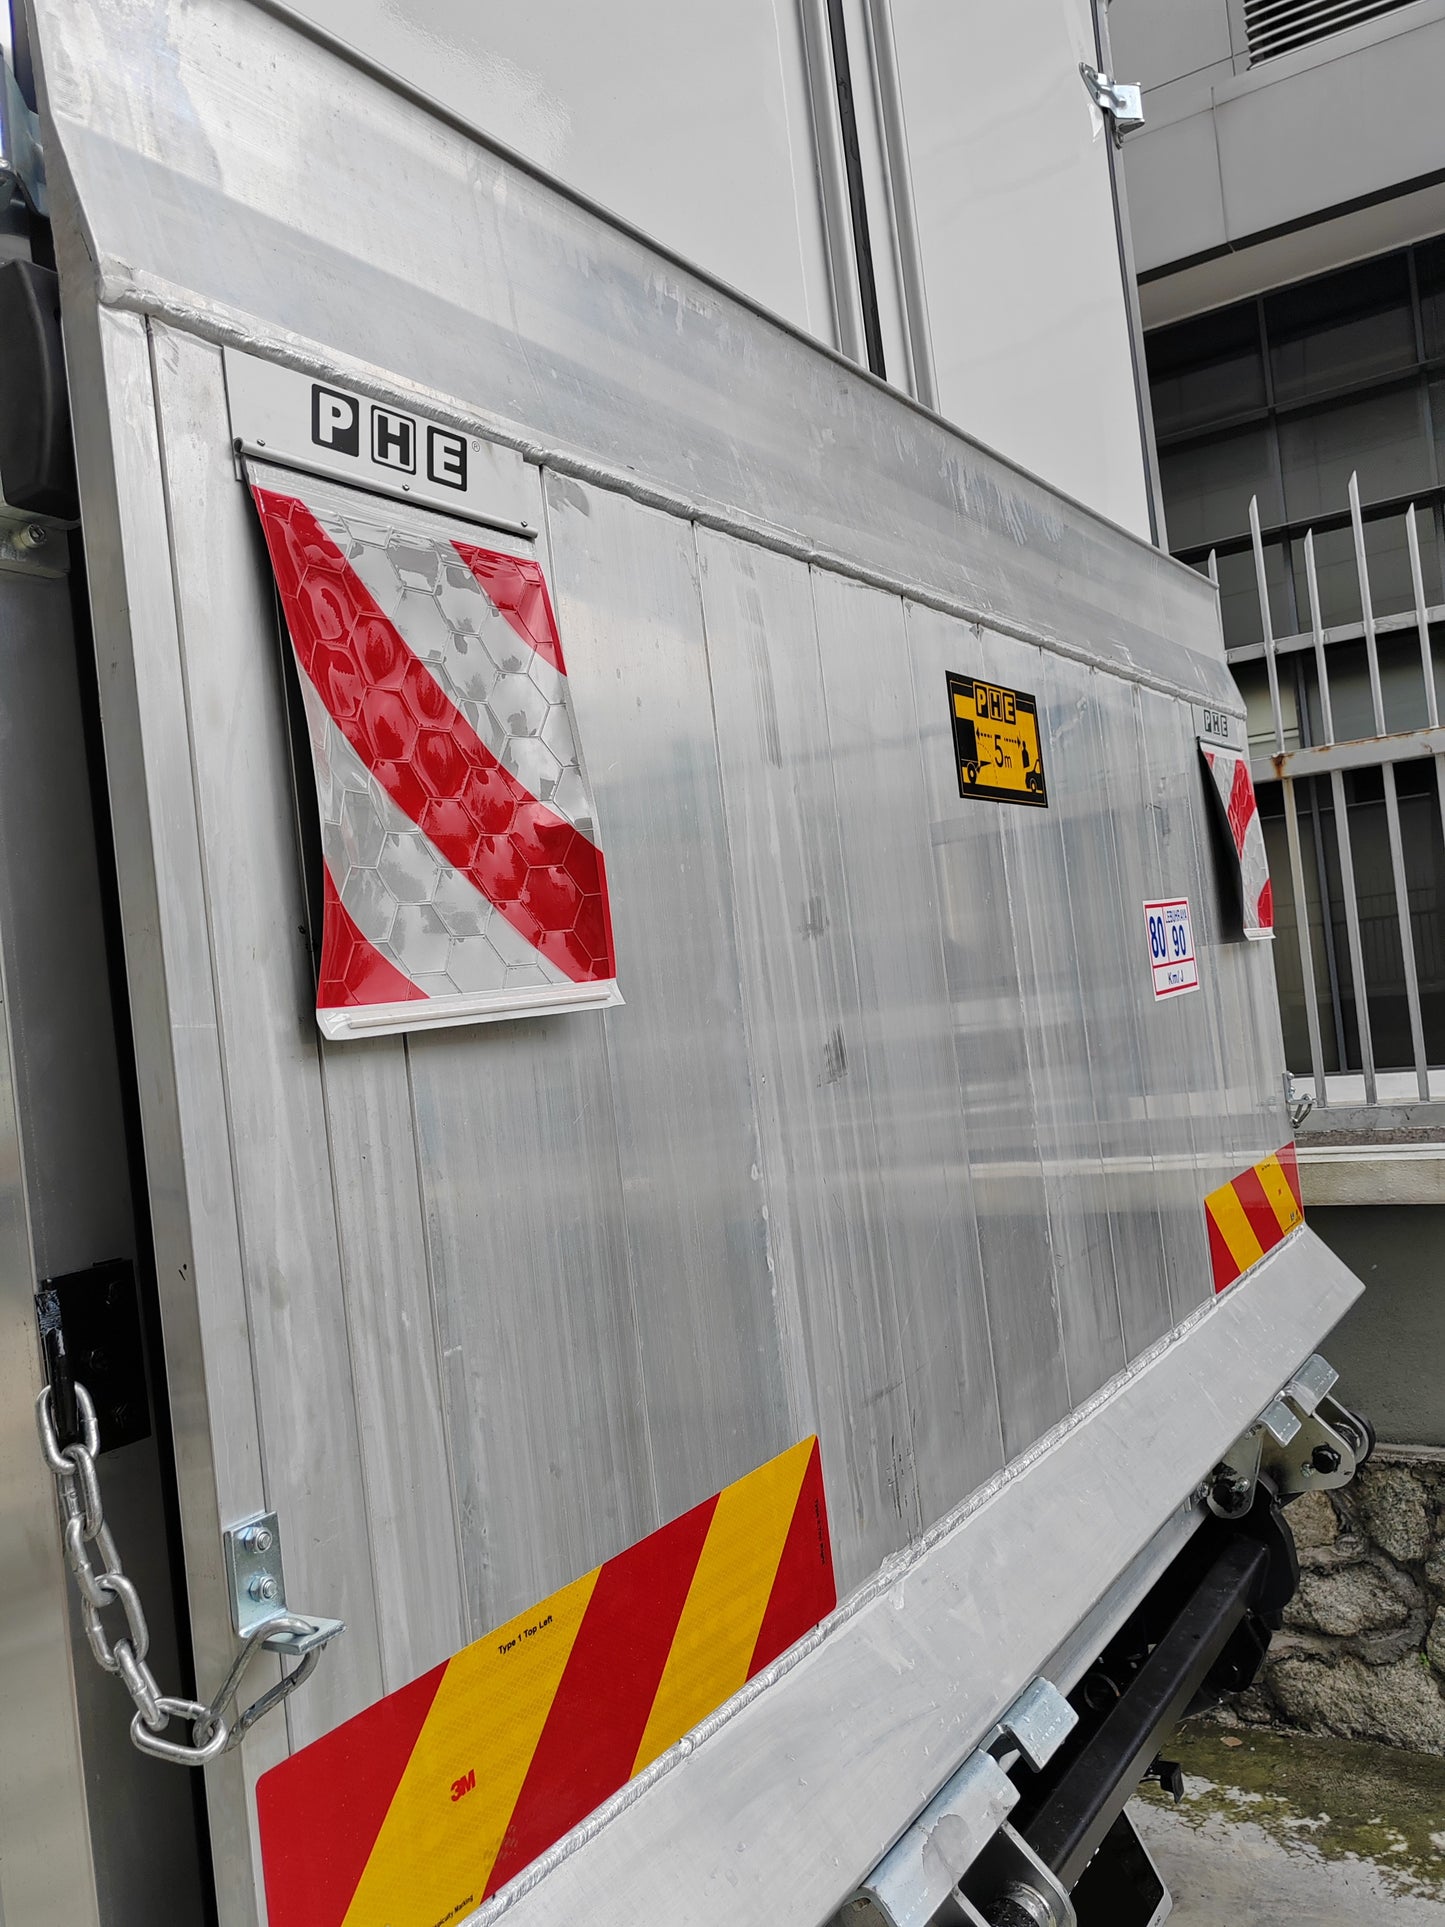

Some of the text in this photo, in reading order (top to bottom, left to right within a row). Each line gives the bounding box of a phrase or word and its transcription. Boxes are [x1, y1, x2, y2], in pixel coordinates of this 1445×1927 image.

[974, 684, 1016, 725] PHE
[1204, 709, 1228, 738] PHE
[1149, 915, 1166, 959] 80
[1172, 924, 1187, 957] 90
[498, 1615, 553, 1655] Type 1 Top Left
[450, 1768, 476, 1802] 3M
